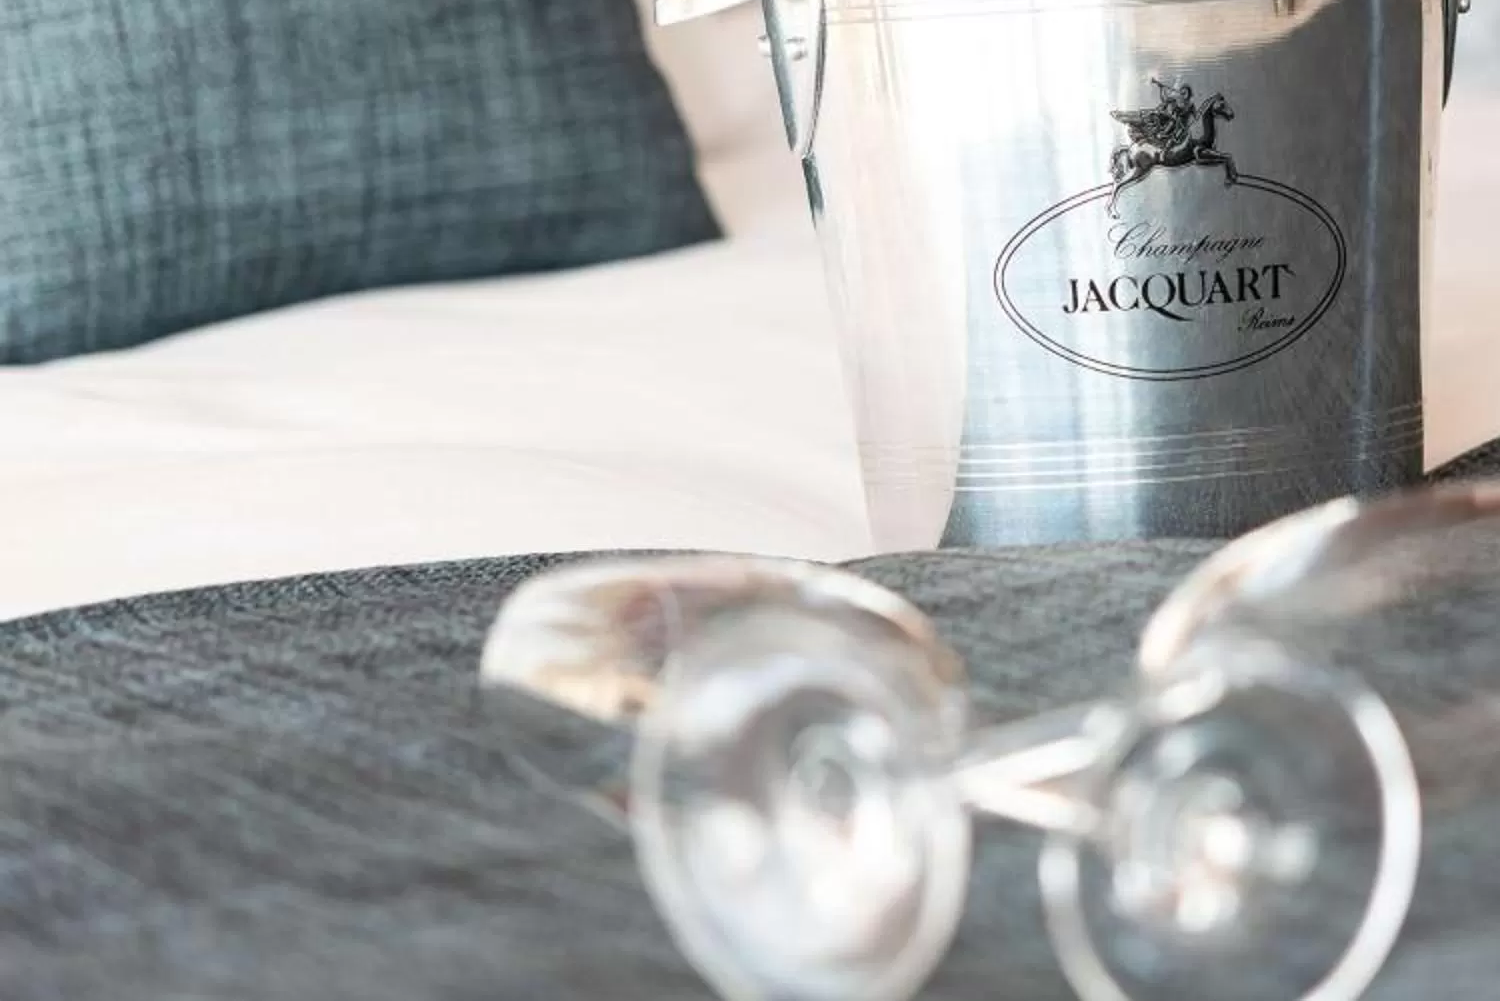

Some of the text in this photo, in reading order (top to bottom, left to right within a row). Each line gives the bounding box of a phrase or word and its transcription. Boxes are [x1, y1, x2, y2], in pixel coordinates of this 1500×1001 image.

[1107, 221, 1266, 264] Champagne
[1062, 263, 1296, 322] JACQUART
[1237, 306, 1296, 333] Reims
